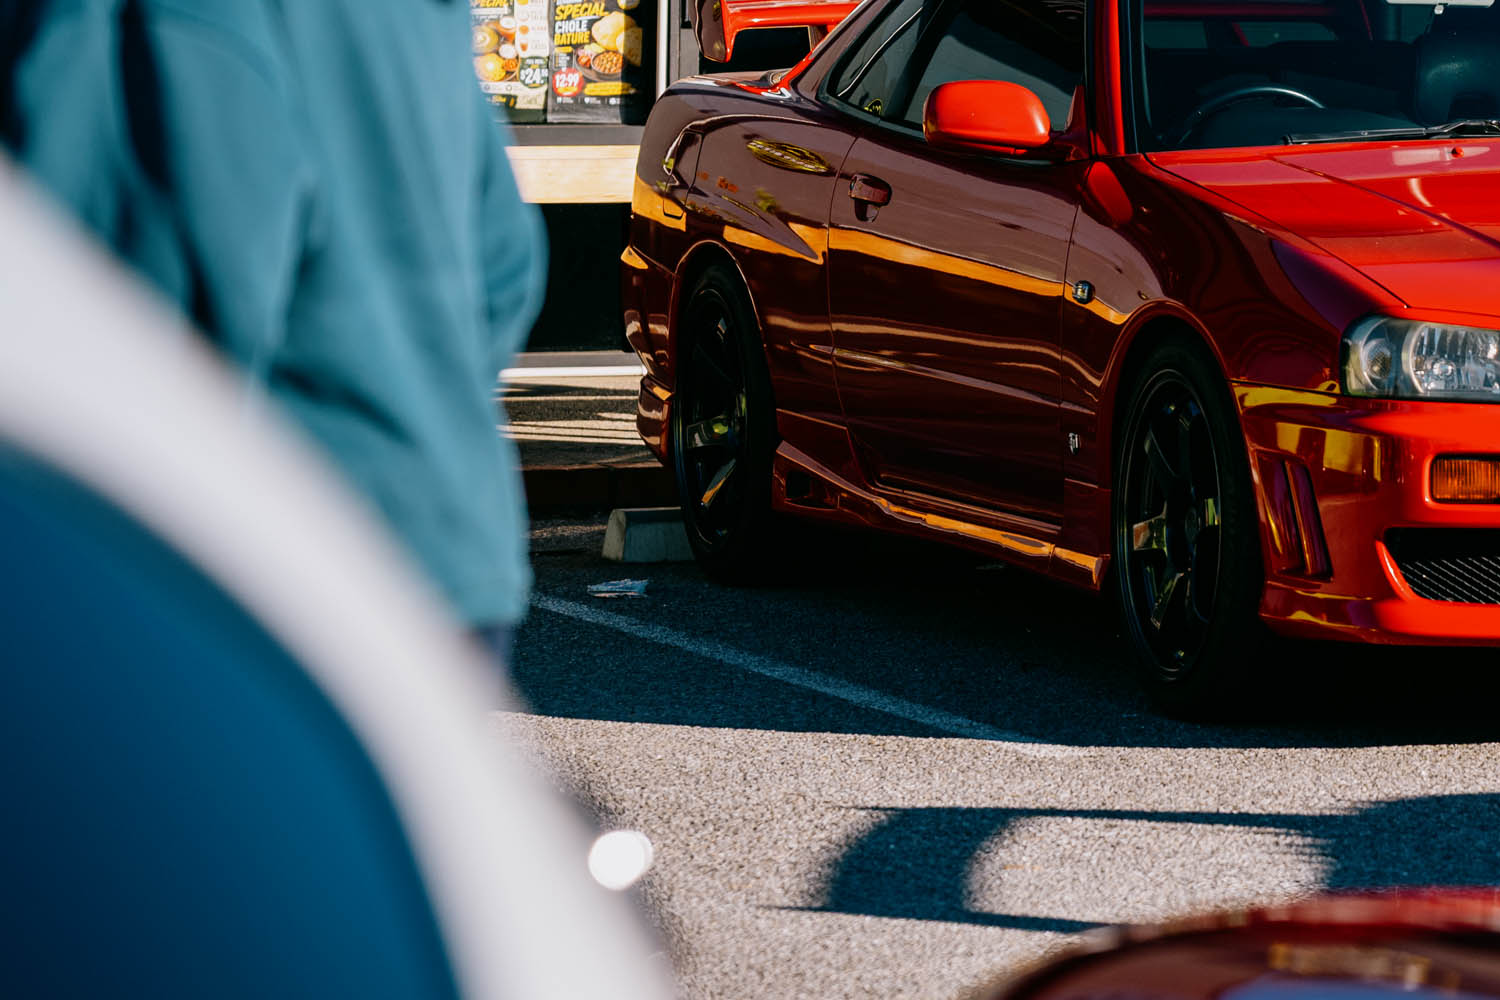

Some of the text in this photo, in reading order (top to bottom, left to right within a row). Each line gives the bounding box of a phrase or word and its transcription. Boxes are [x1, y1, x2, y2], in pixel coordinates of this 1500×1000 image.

[555, 2, 609, 21] SPECIAL
[555, 20, 588, 33] CHOLE
[554, 31, 591, 45] BATURE
